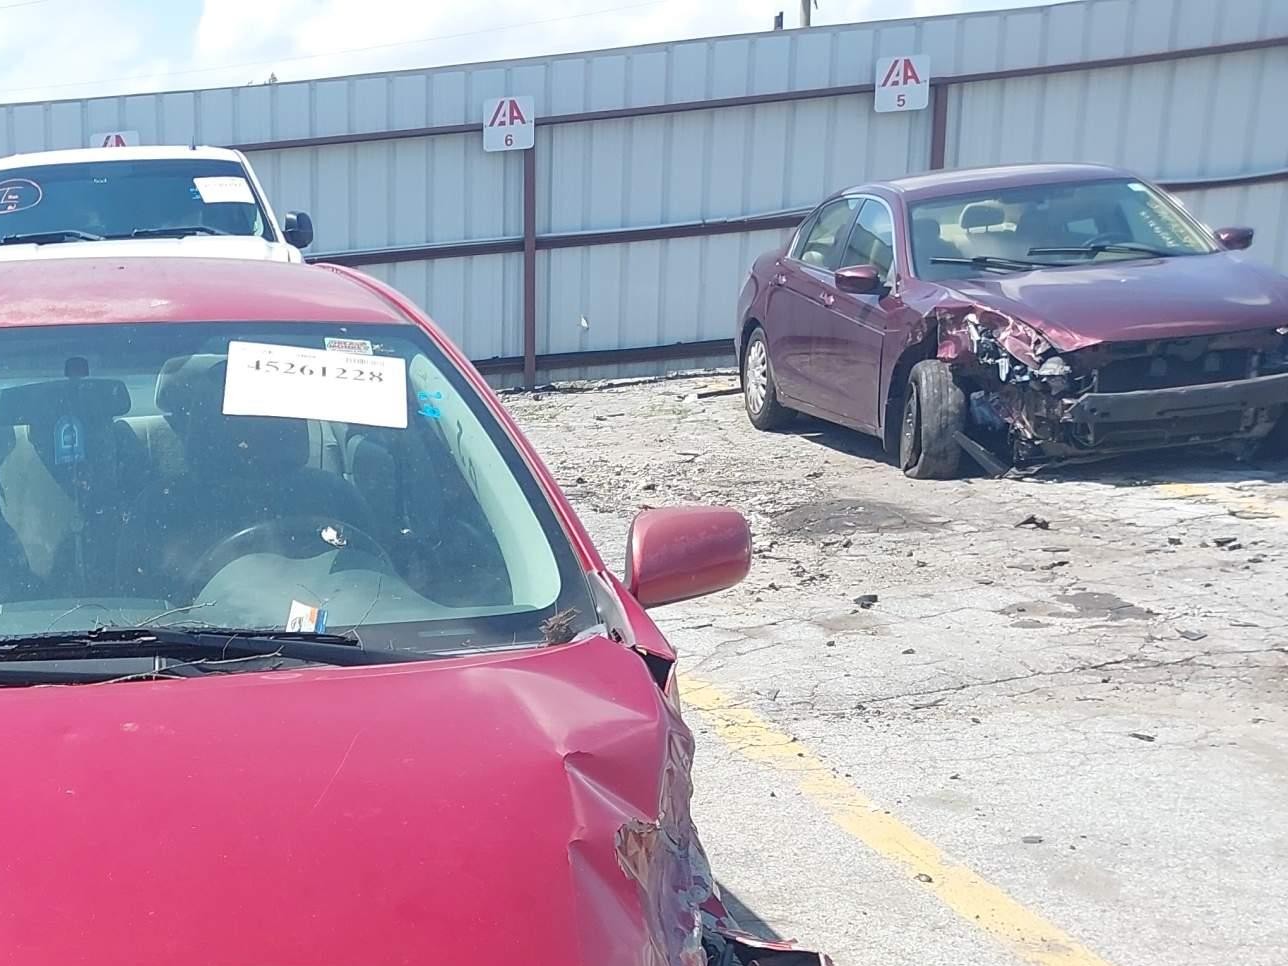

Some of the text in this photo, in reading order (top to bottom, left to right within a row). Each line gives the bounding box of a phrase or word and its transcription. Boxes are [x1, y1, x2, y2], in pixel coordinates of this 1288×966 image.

[896, 94, 906, 107] 5
[504, 134, 514, 147] 6
[248, 359, 384, 383] 45261228
